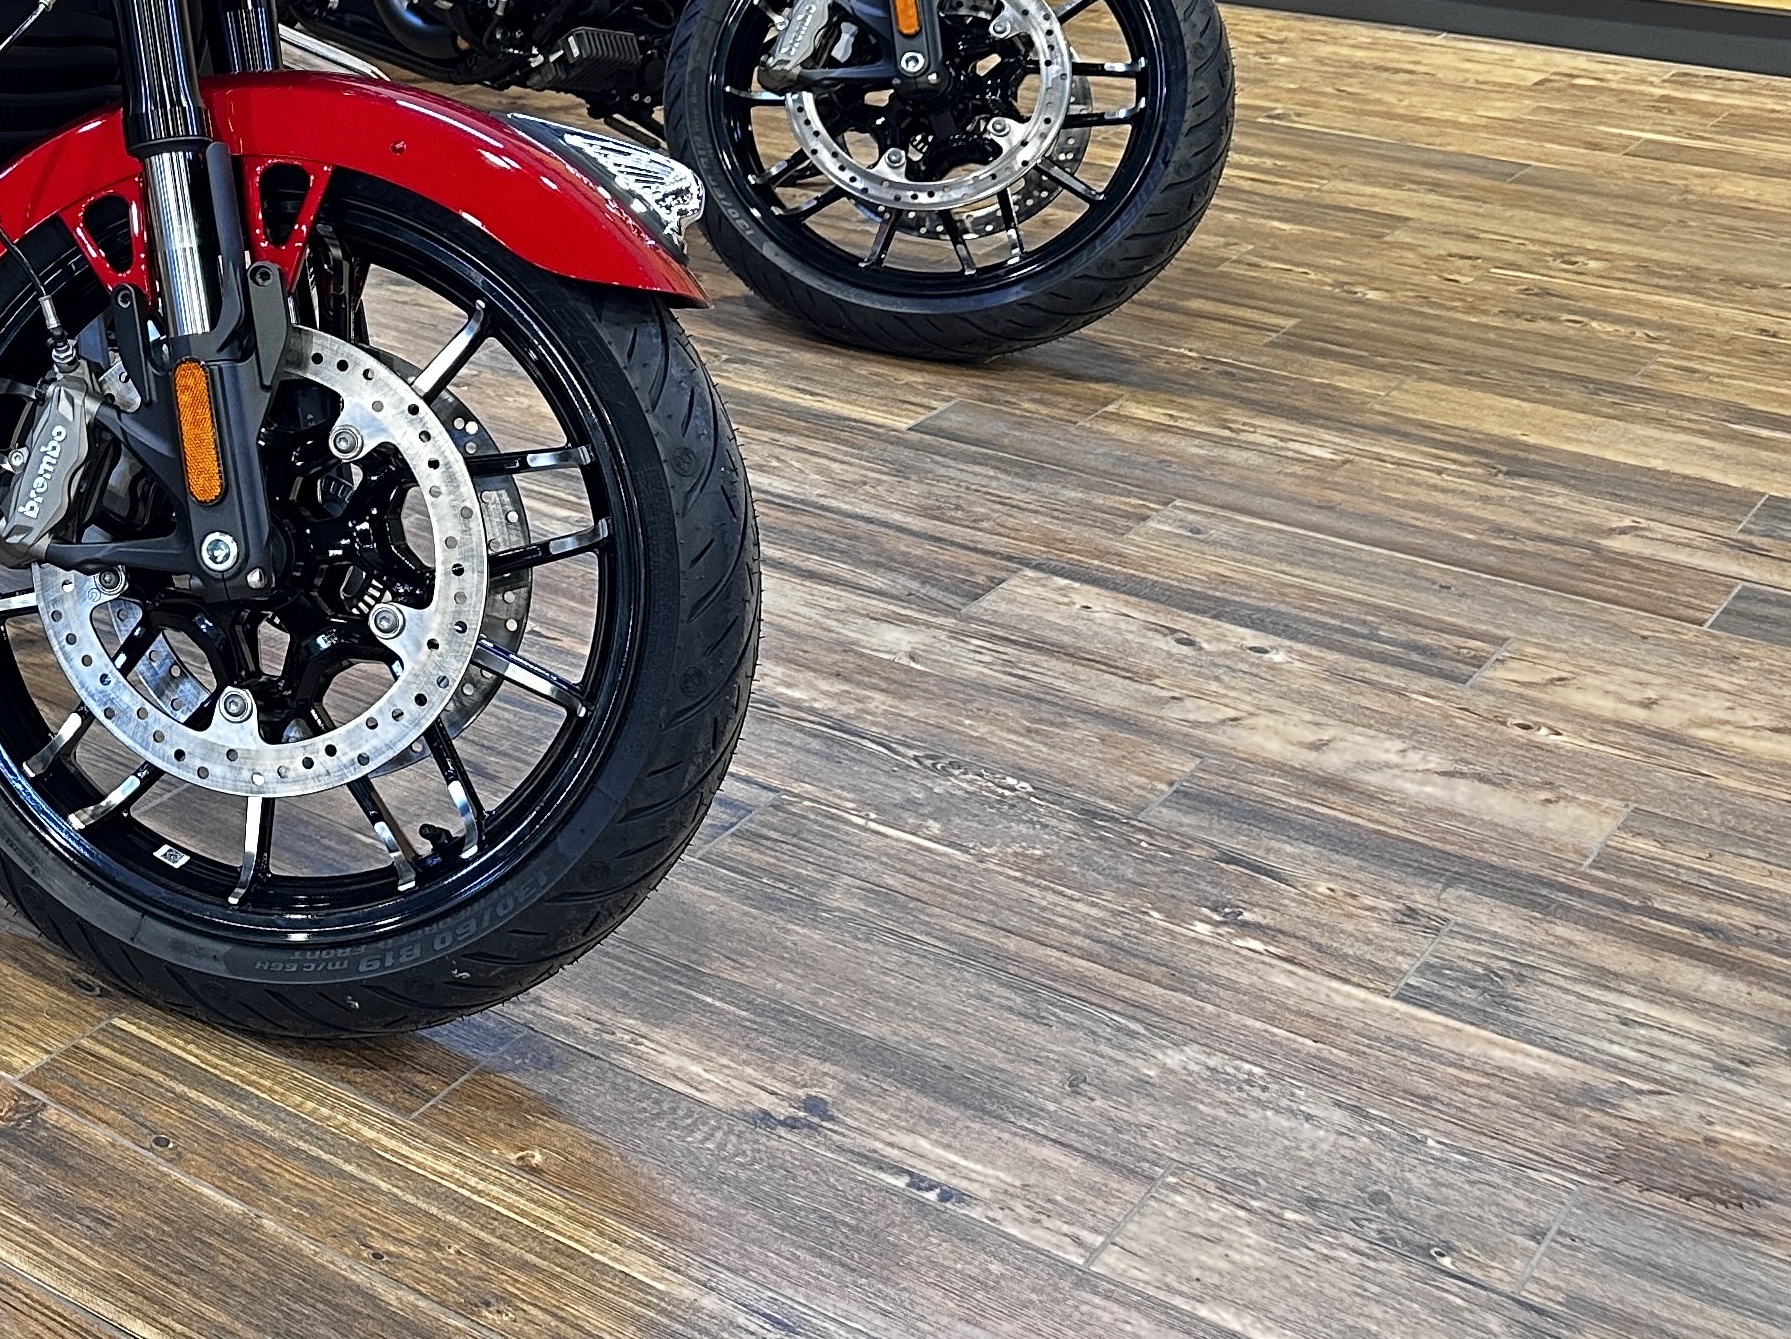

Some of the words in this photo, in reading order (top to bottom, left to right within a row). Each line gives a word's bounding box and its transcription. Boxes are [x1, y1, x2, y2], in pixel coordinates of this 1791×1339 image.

[17, 424, 68, 520] brembo
[430, 864, 552, 952] 130/60
[357, 942, 423, 973] B19
